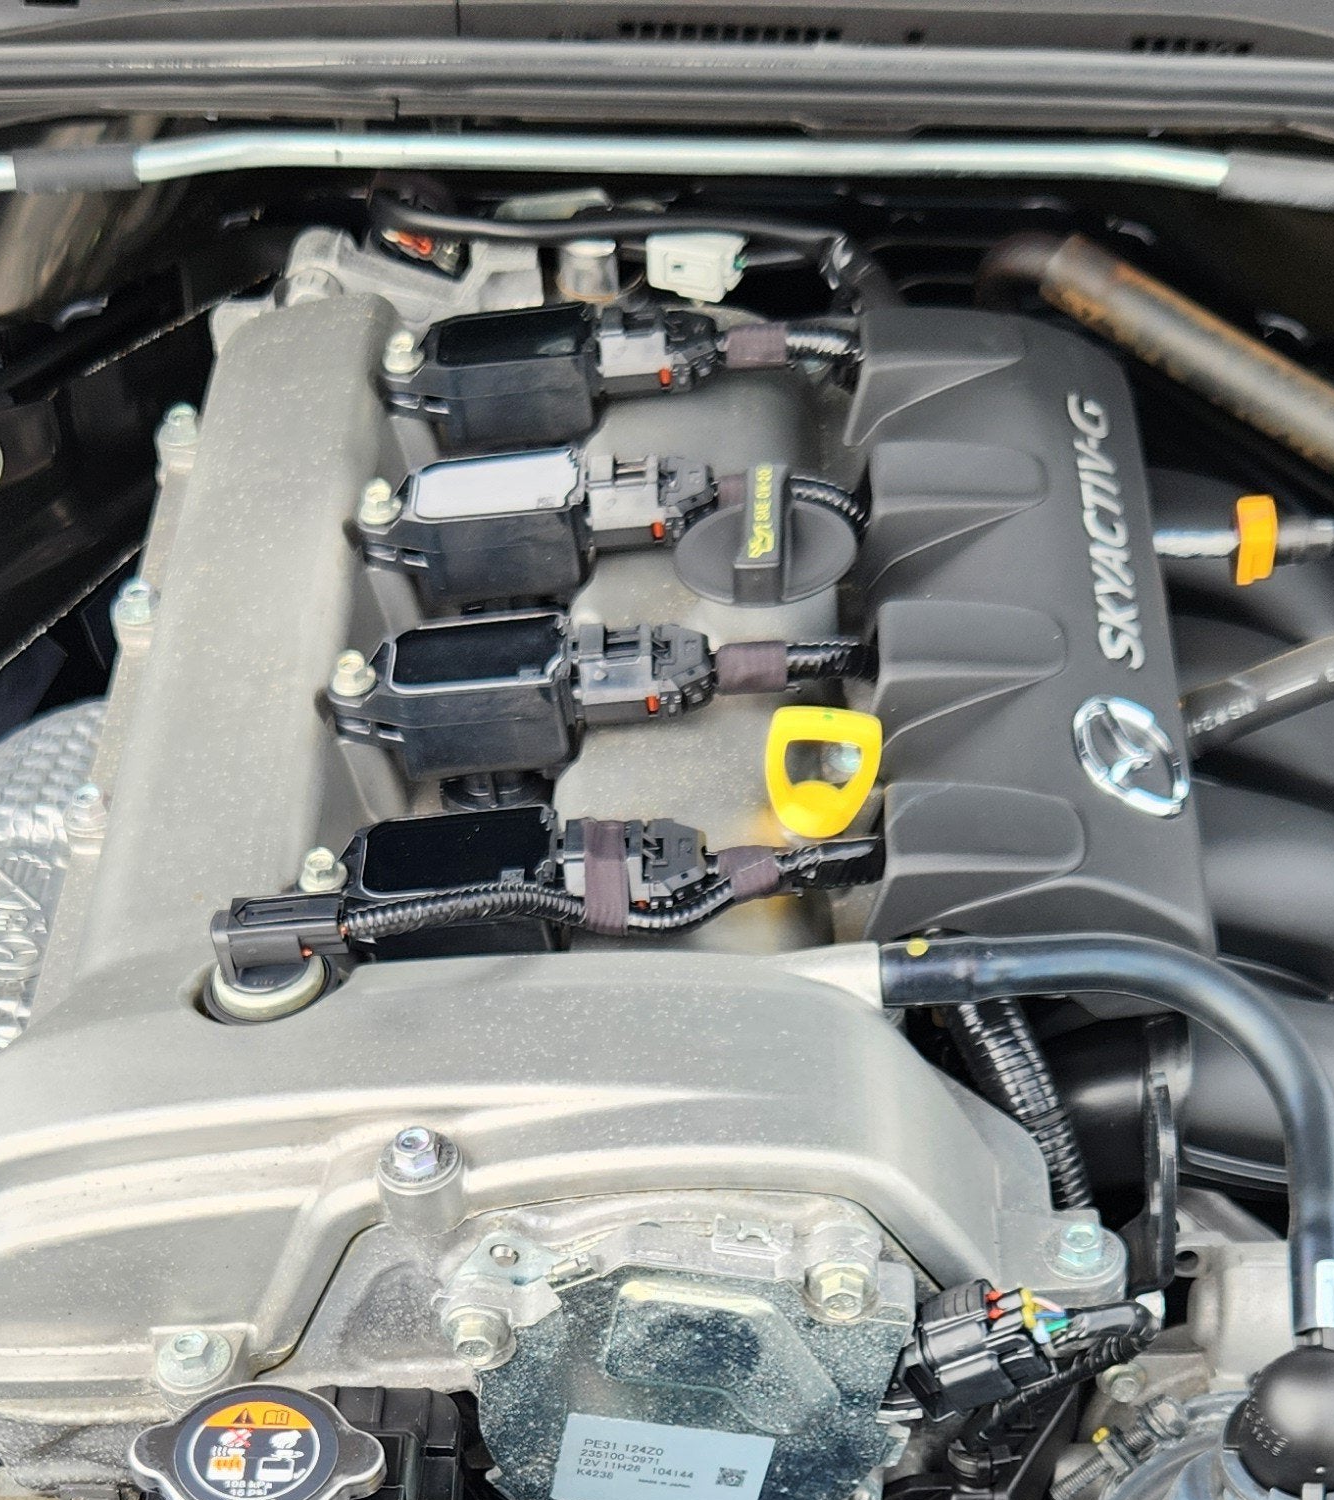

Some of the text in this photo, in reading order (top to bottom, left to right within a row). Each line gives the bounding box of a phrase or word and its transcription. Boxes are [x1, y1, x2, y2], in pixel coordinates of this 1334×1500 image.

[1067, 392, 1145, 670] SKYACTIV-G
[584, 1438, 617, 1450] PE31
[580, 1449, 660, 1466] 235100-0971
